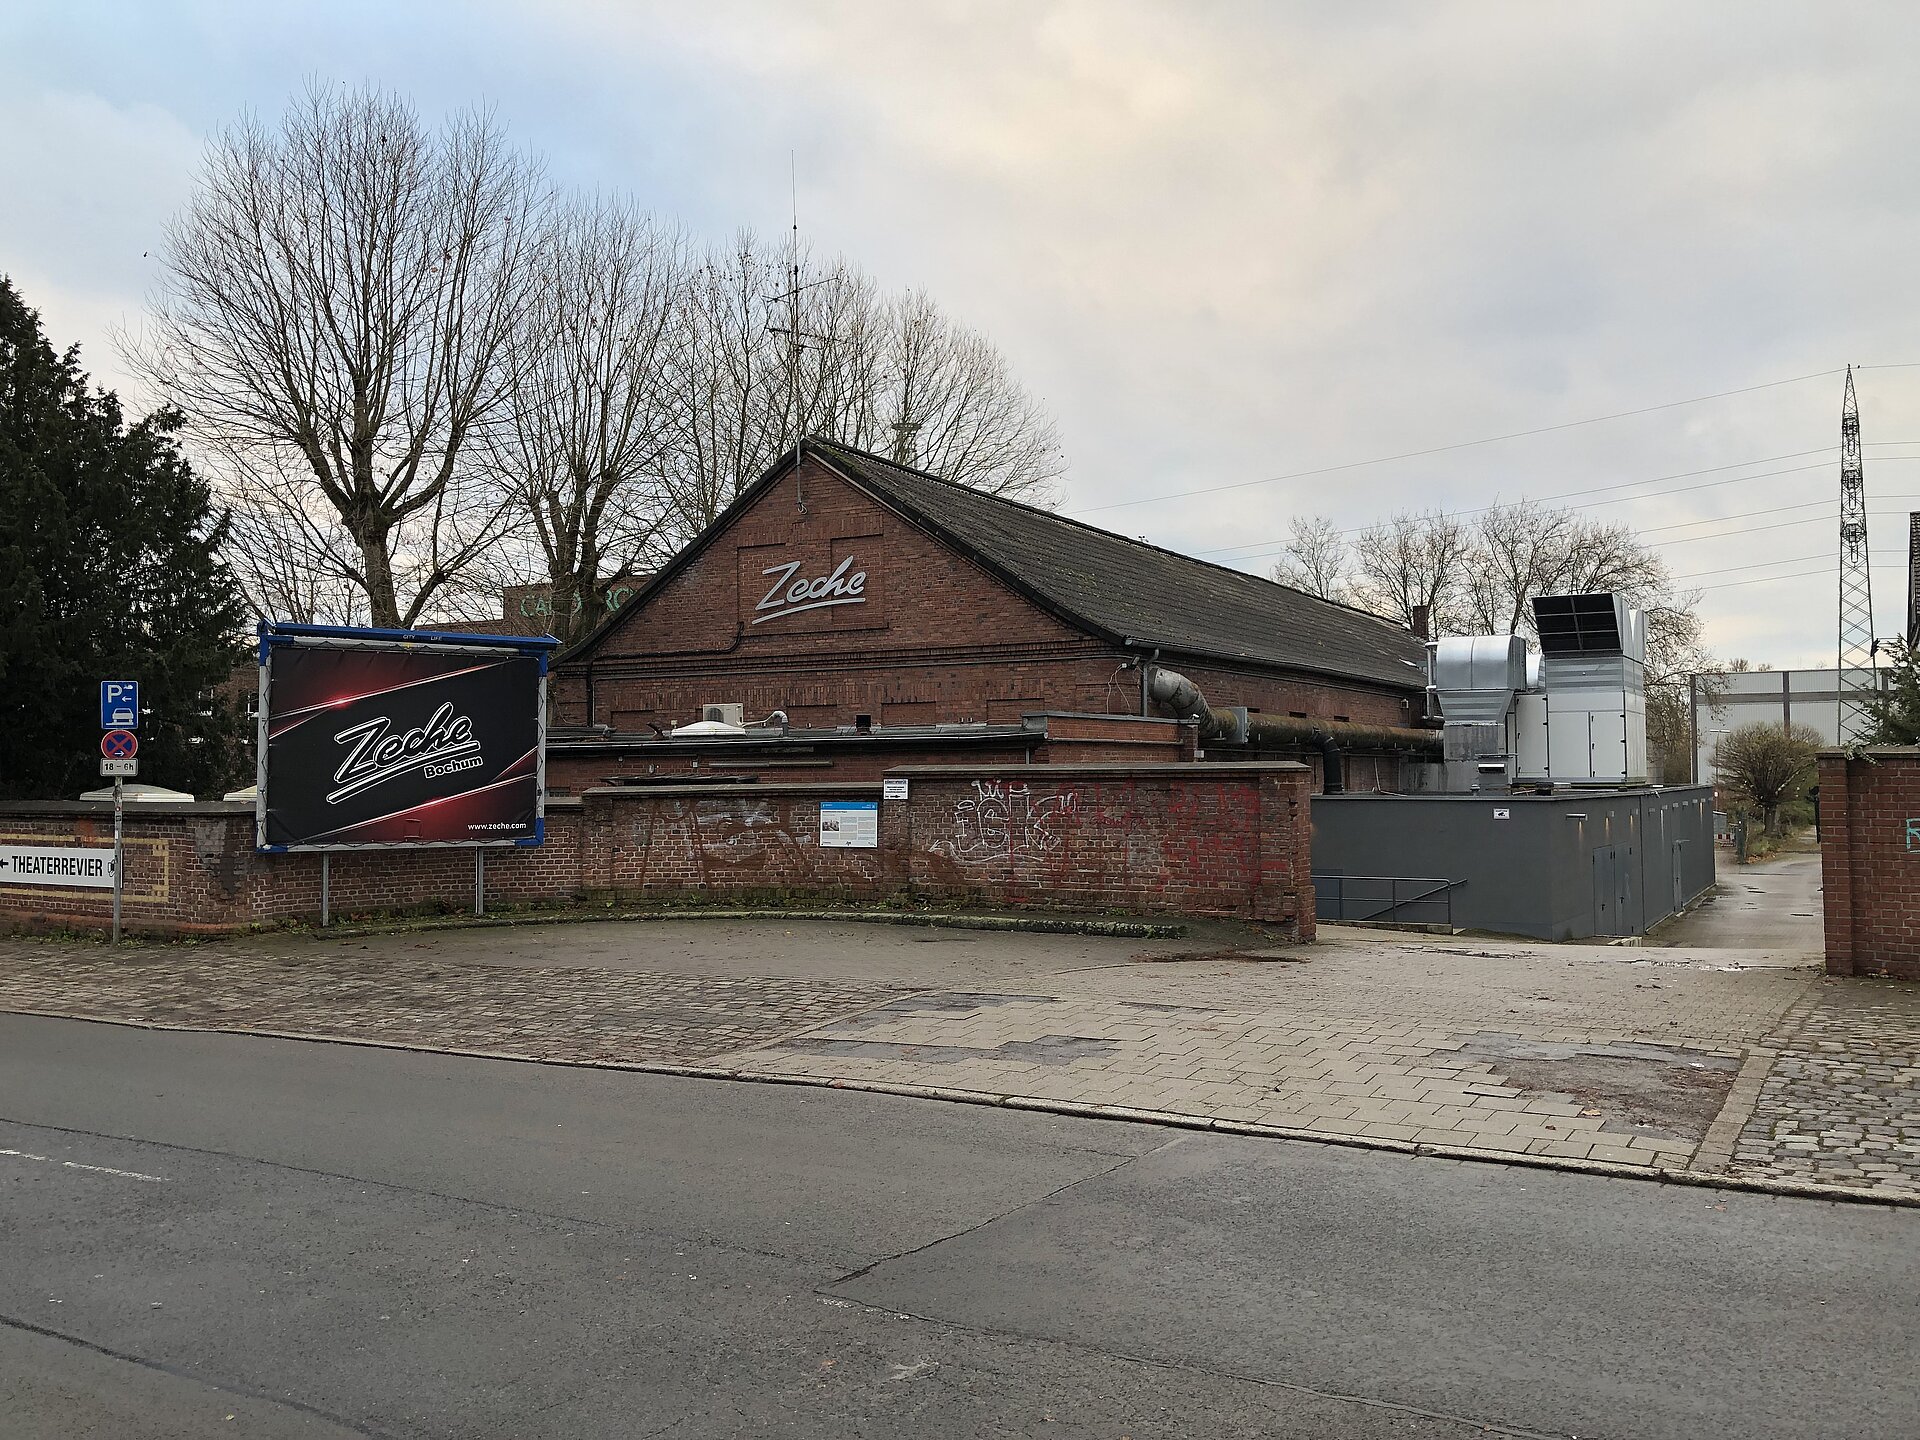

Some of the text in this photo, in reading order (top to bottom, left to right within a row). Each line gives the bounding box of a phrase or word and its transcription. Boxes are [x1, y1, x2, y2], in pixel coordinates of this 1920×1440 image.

[754, 555, 867, 611] Zeche
[107, 685, 123, 703] P
[333, 702, 473, 784] Zeche
[104, 763, 114, 771] 18
[124, 763, 134, 771] 6h
[424, 756, 483, 779] Bochum
[467, 822, 527, 831] www.zeche.com
[11, 855, 103, 877] THEATERREVIER
